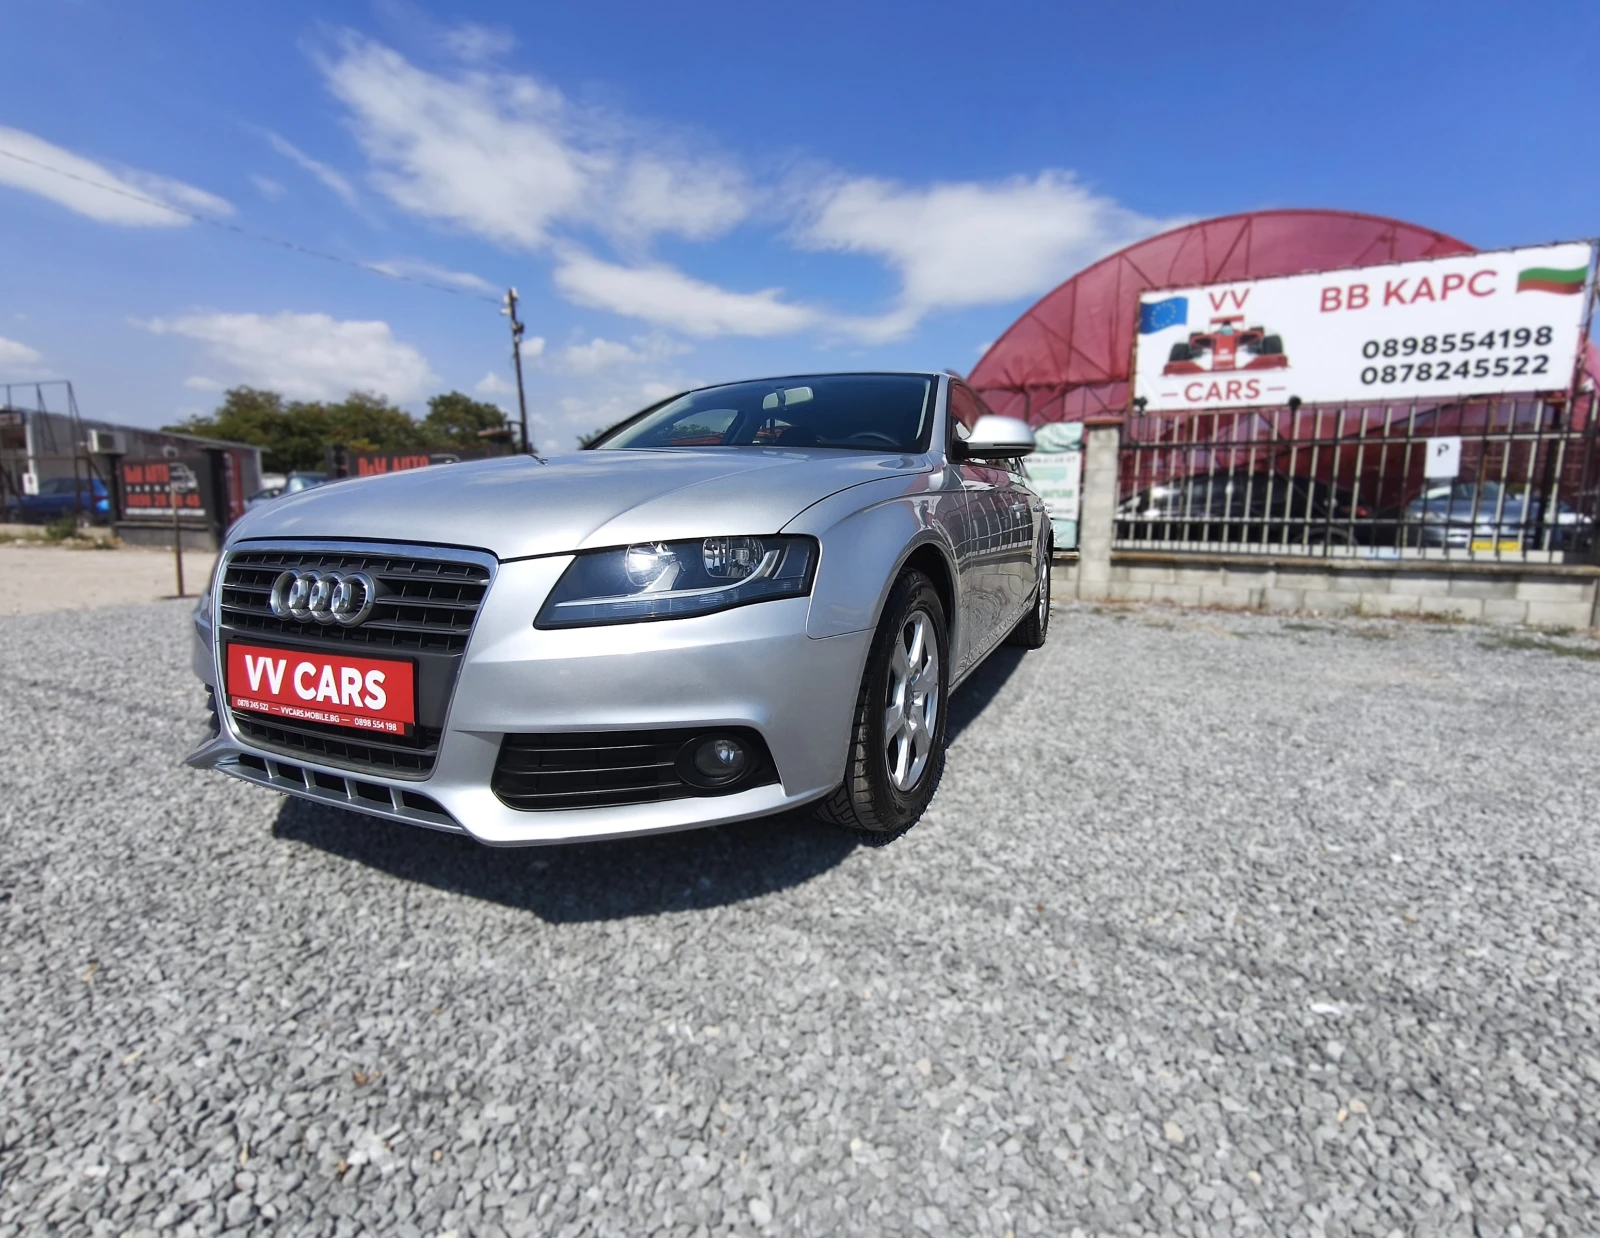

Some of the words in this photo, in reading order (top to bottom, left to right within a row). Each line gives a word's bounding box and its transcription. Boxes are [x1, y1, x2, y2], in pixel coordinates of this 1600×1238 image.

[1208, 288, 1250, 312] VV
[1319, 283, 1370, 313] ВВ
[1383, 269, 1498, 308] КАРС
[1362, 325, 1554, 359] 0898554198
[1360, 354, 1550, 385] 0878245522
[1184, 378, 1261, 403] CARS
[245, 654, 287, 695] VV
[293, 661, 387, 710] CARS
[237, 698, 250, 707] 0878
[250, 700, 260, 709] 245
[259, 702, 269, 711] 522
[354, 717, 372, 727] 0898
[372, 719, 385, 729] 554
[385, 721, 397, 731] 198
